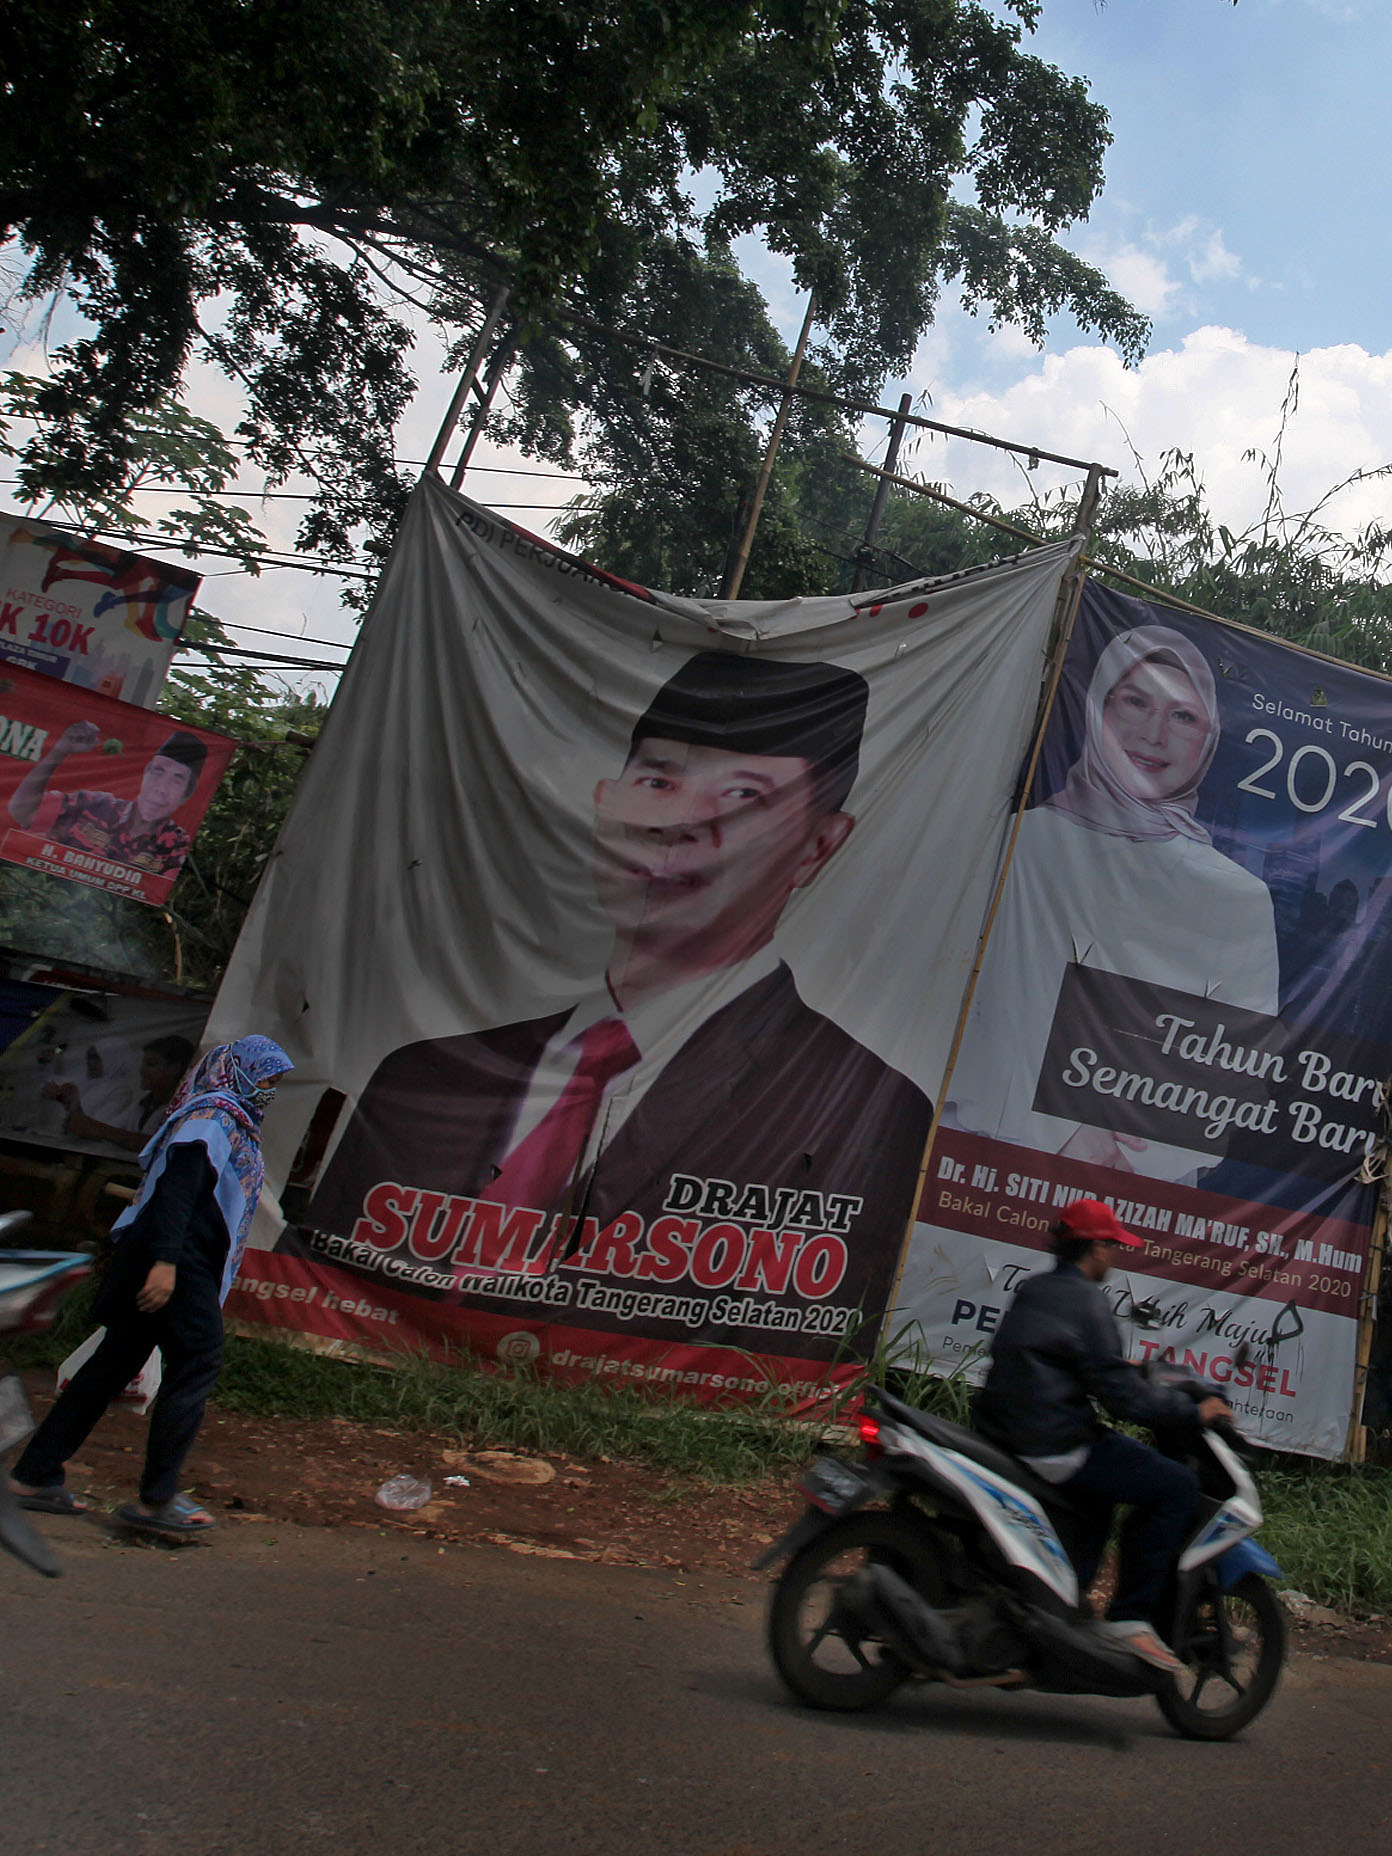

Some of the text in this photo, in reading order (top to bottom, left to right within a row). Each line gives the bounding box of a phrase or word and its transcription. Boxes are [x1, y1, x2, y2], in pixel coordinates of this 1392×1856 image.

[28, 614, 96, 656] 10K
[1252, 693, 1333, 734] Selamat
[1155, 1013, 1288, 1084] Tahun
[1062, 1047, 1280, 1140] Semangat
[663, 1173, 864, 1233] DRAJAT
[937, 1156, 966, 1184] Dr.
[971, 1164, 1000, 1193] Hj.
[1005, 1172, 1051, 1204] SITI
[1174, 1213, 1250, 1252] MA'RUF,
[1293, 1238, 1363, 1274] M.Hum
[938, 1190, 990, 1218] Bakal
[996, 1205, 1050, 1233] Calon
[1142, 1238, 1233, 1277] Tangerang
[1238, 1260, 1302, 1287] Selatan
[1308, 1274, 1352, 1298] 2020
[321, 1290, 400, 1326] hebat
[382, 1256, 458, 1291] Calon
[576, 1278, 709, 1328] Tangerang
[709, 1295, 803, 1333] Selatan
[1139, 1340, 1297, 1398] TANGSEL
